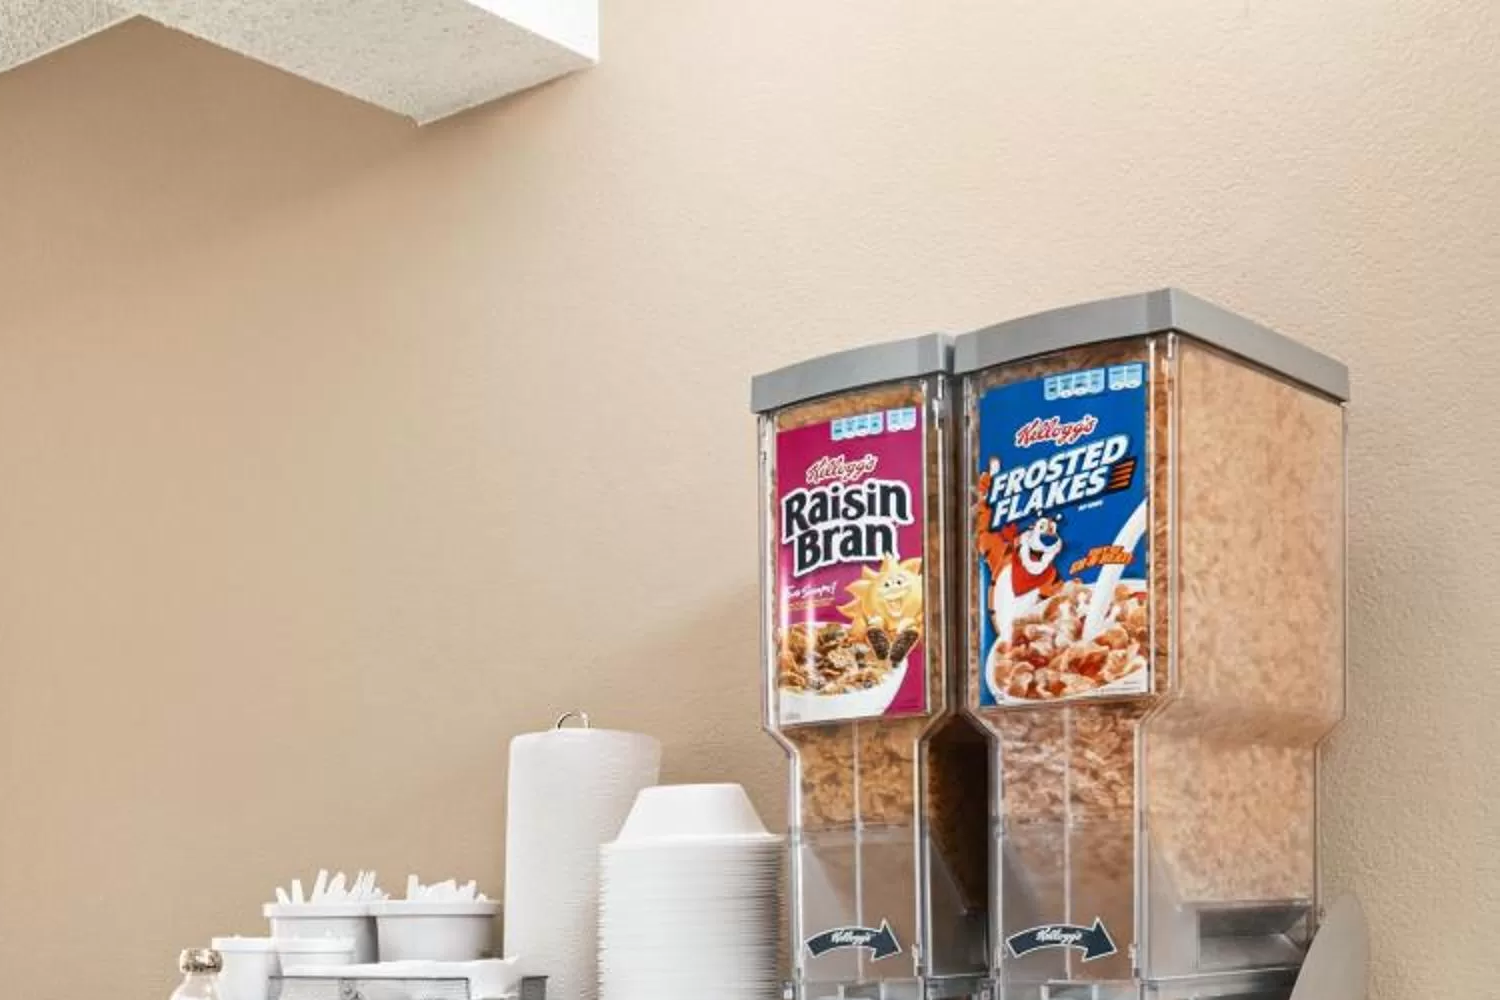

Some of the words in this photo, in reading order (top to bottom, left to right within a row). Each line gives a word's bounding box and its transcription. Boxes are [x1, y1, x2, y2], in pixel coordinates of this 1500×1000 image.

[1015, 414, 1098, 447] Kellogg's
[806, 454, 878, 484] Kellogg's
[989, 434, 1128, 503] FROSTED
[784, 481, 910, 541] Raisin
[991, 465, 1108, 528] FLAKES
[796, 523, 894, 573] Bran
